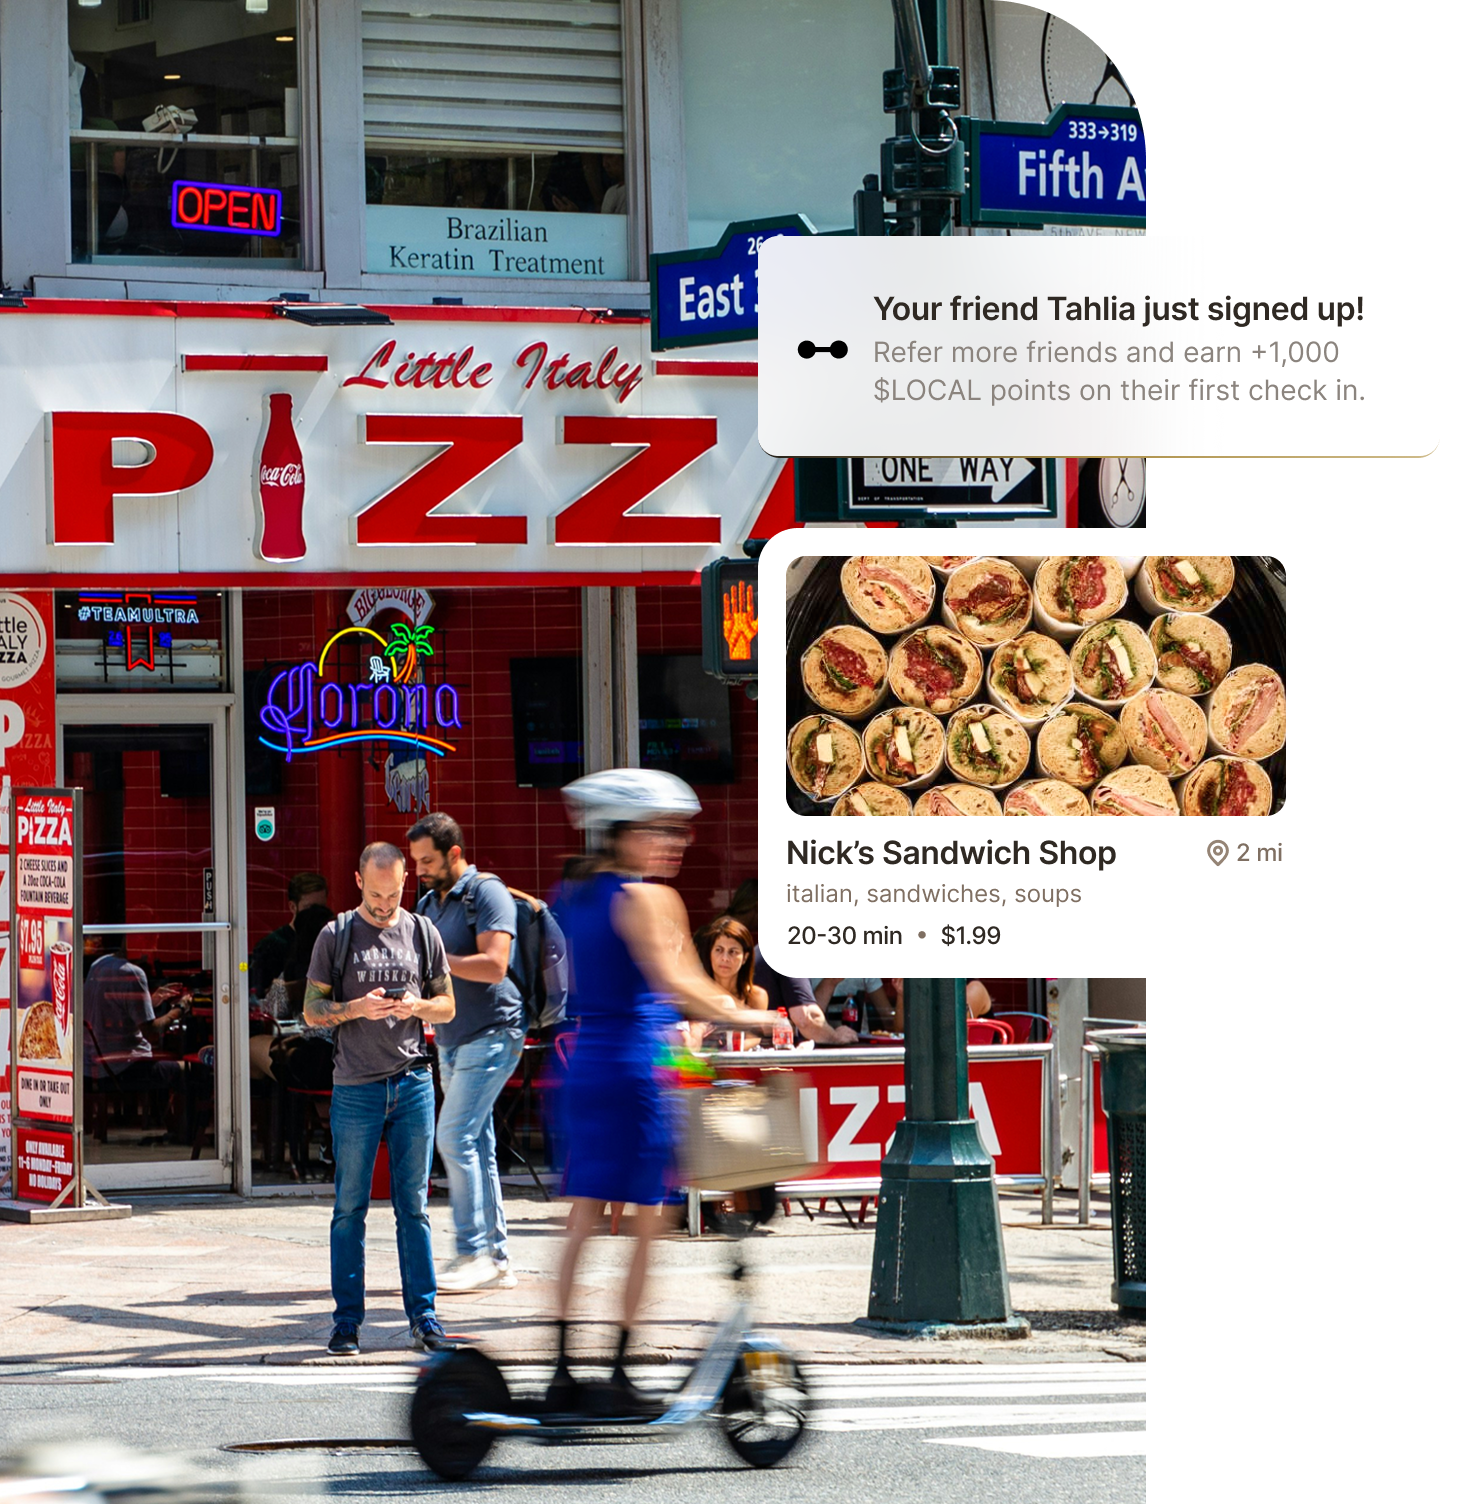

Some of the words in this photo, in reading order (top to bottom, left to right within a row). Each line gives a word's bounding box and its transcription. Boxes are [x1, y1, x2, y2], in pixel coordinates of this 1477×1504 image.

[1069, 121, 1096, 140] 333
[1111, 123, 1137, 142] 319
[1019, 149, 1103, 199] Fifth
[1116, 156, 1146, 201] A
[177, 186, 277, 231] OPEN
[446, 216, 548, 244] Brazilian
[389, 245, 475, 272] Keratin
[492, 249, 605, 276] Treatment
[679, 273, 744, 321] East
[343, 338, 493, 391] Little
[516, 341, 644, 404] Italy
[881, 458, 933, 482] ONE
[958, 458, 1013, 482] WAY
[78, 606, 199, 623] #TEAMULTRA
[2, 667, 30, 682] GOURMET
[29, 649, 40, 668] PIZZA
[260, 662, 462, 763] Corona
[24, 797, 45, 813] Little
[46, 798, 66, 816] Italy
[18, 815, 72, 846] PIZZA
[20, 858, 23, 870] 2
[24, 858, 40, 871] CHEESE
[41, 860, 56, 873] SLICES
[57, 860, 68, 873] AND
[23, 874, 27, 886] A
[28, 874, 39, 887] 20oz
[40, 875, 66, 888] COCA-COLA
[20, 890, 43, 903] FOUNTAIN
[44, 891, 69, 905] BEVERAGE
[21, 919, 43, 955] $7.95
[353, 947, 420, 965] AMERICAN
[21, 1078, 32, 1090] DINE
[33, 1079, 39, 1091] IN
[40, 1080, 46, 1092] OR
[48, 1081, 59, 1094] TAKE
[60, 1082, 70, 1094] OUT
[1, 1100, 11, 1110] OU
[39, 1095, 51, 1108] ONLY
[2, 1128, 11, 1138] YO
[25, 1140, 38, 1154] ONLY
[38, 1141, 65, 1158] AVAILABLE
[37, 1174, 62, 1191] HOLIDAYS
